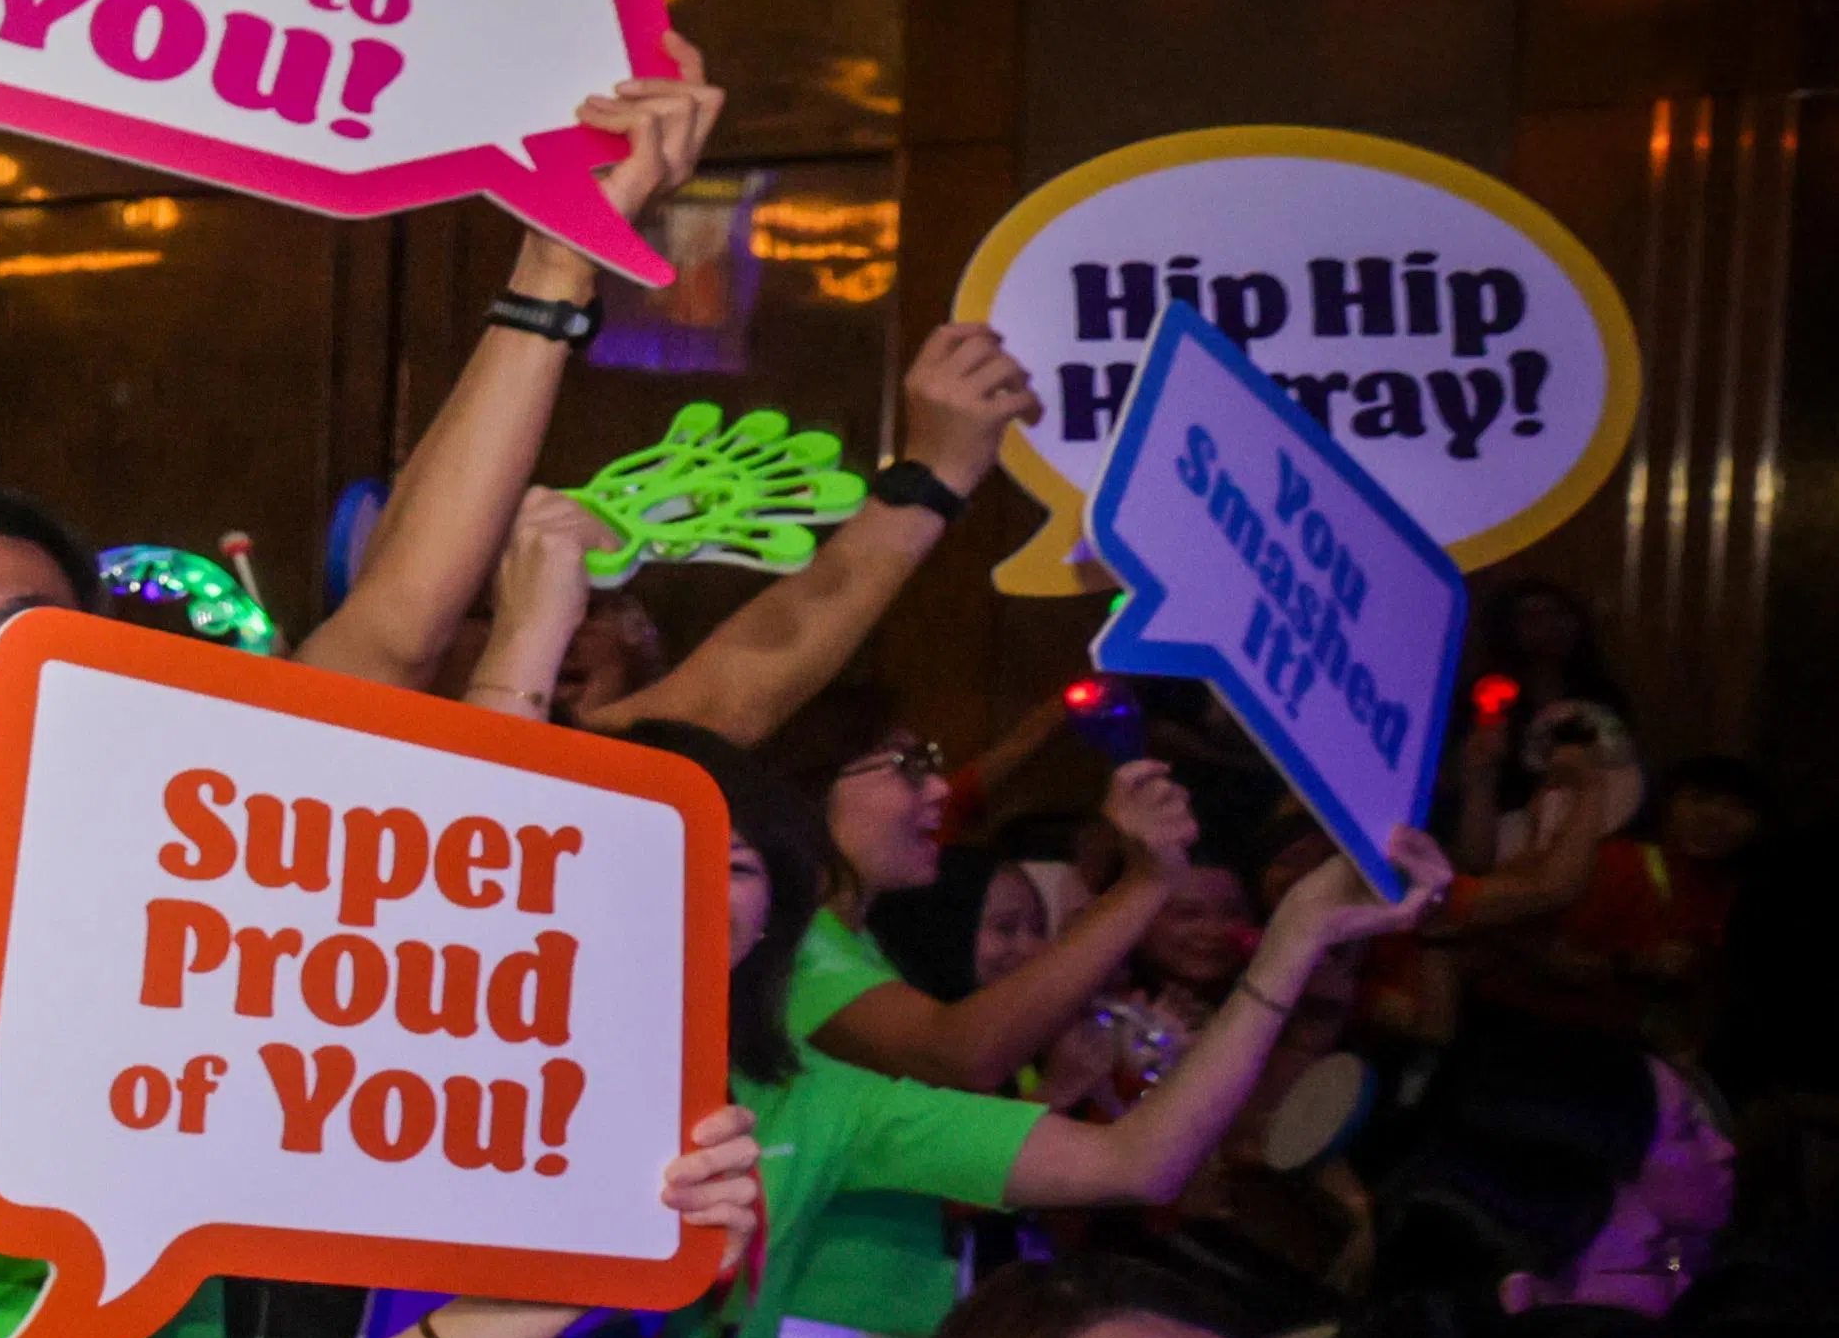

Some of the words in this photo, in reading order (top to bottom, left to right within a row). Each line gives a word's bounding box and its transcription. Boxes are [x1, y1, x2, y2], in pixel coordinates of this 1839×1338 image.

[1071, 255, 1289, 359] Hip
[1308, 250, 1526, 357] Hip
[1057, 348, 1550, 460] Hray!
[1174, 423, 1411, 772] Smashed
[1275, 447, 1368, 623] You
[1242, 596, 1316, 721] It!
[157, 767, 583, 928] Super
[140, 897, 579, 1048] Proud
[107, 1055, 228, 1135] of
[257, 1042, 588, 1179] You!
